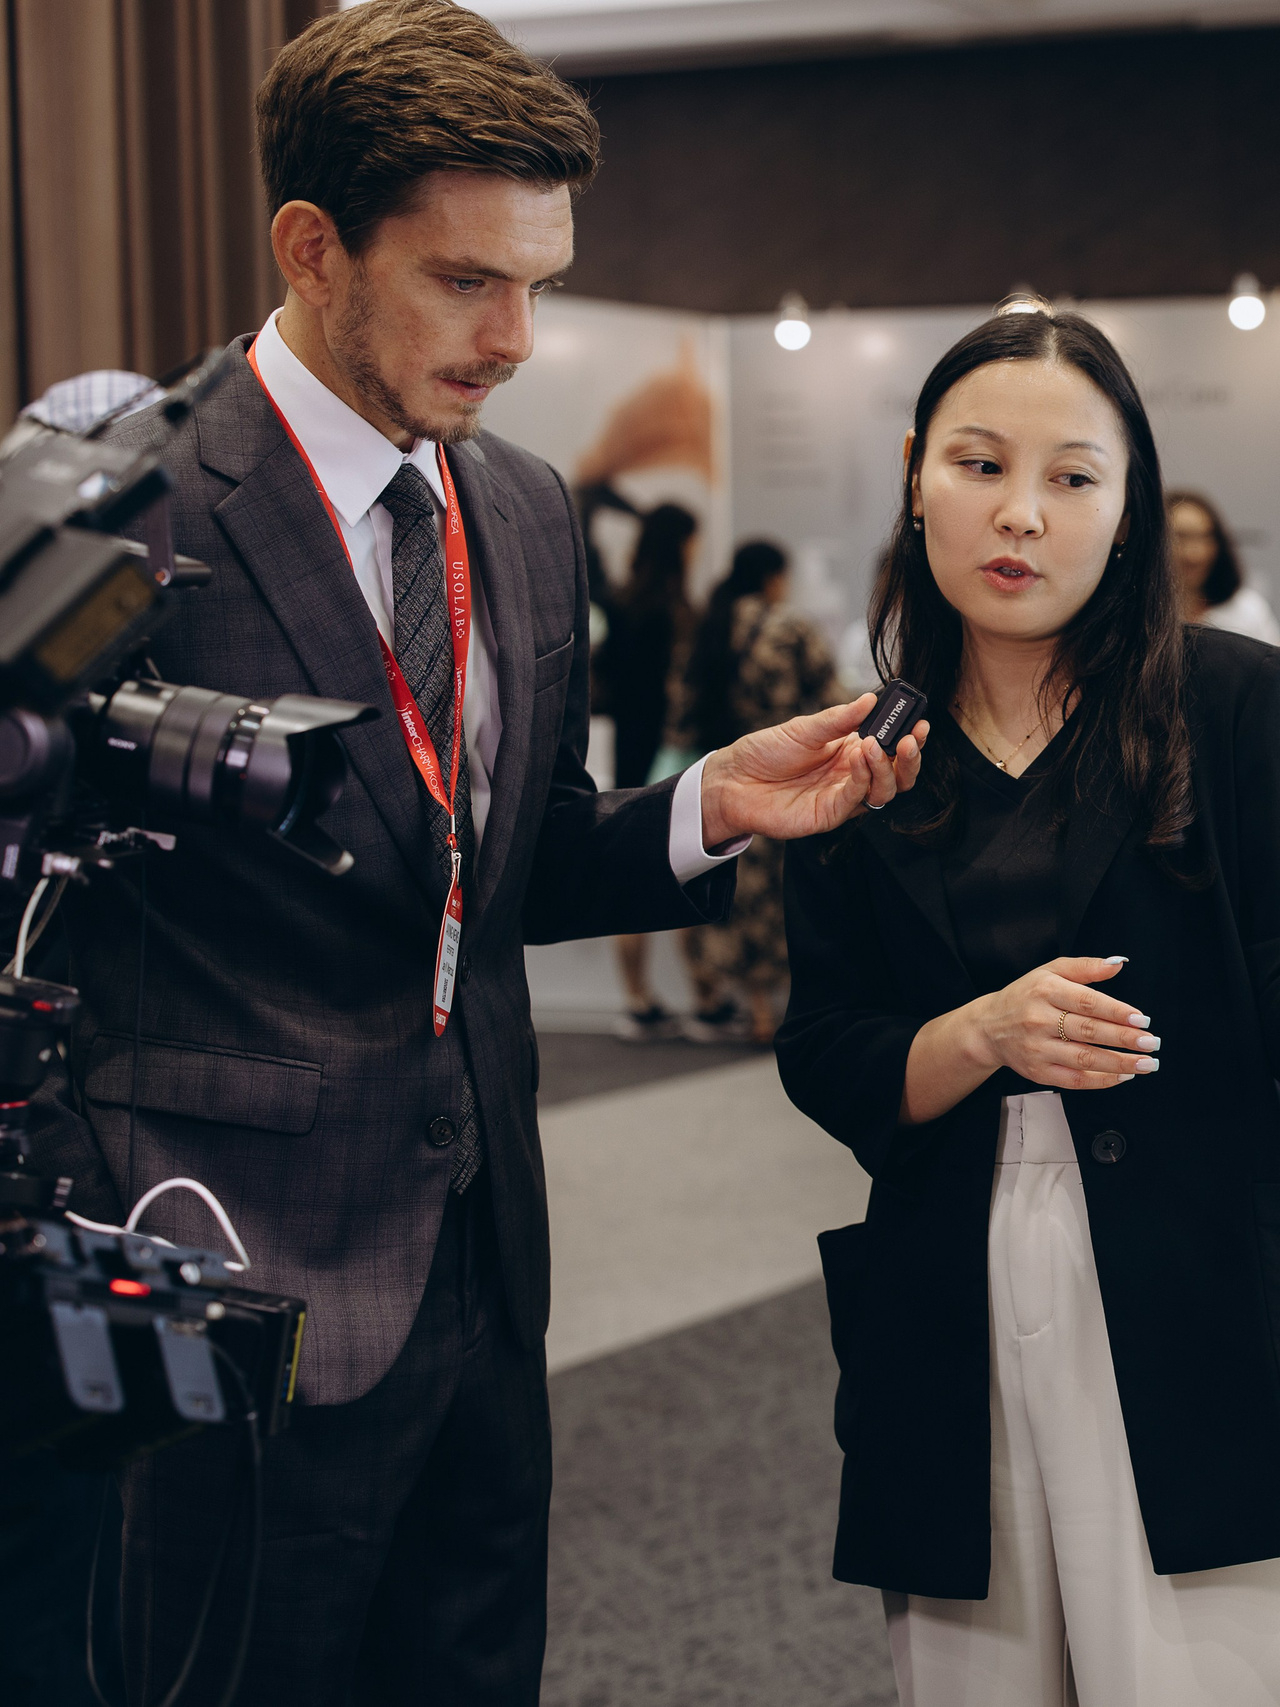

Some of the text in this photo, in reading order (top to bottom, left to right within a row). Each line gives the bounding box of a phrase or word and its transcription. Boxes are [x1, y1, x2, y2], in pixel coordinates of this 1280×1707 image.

[452, 561, 466, 627] USOLAB
[401, 710, 434, 771] interCHARM
[876, 698, 907, 740] HOLLYLAND
